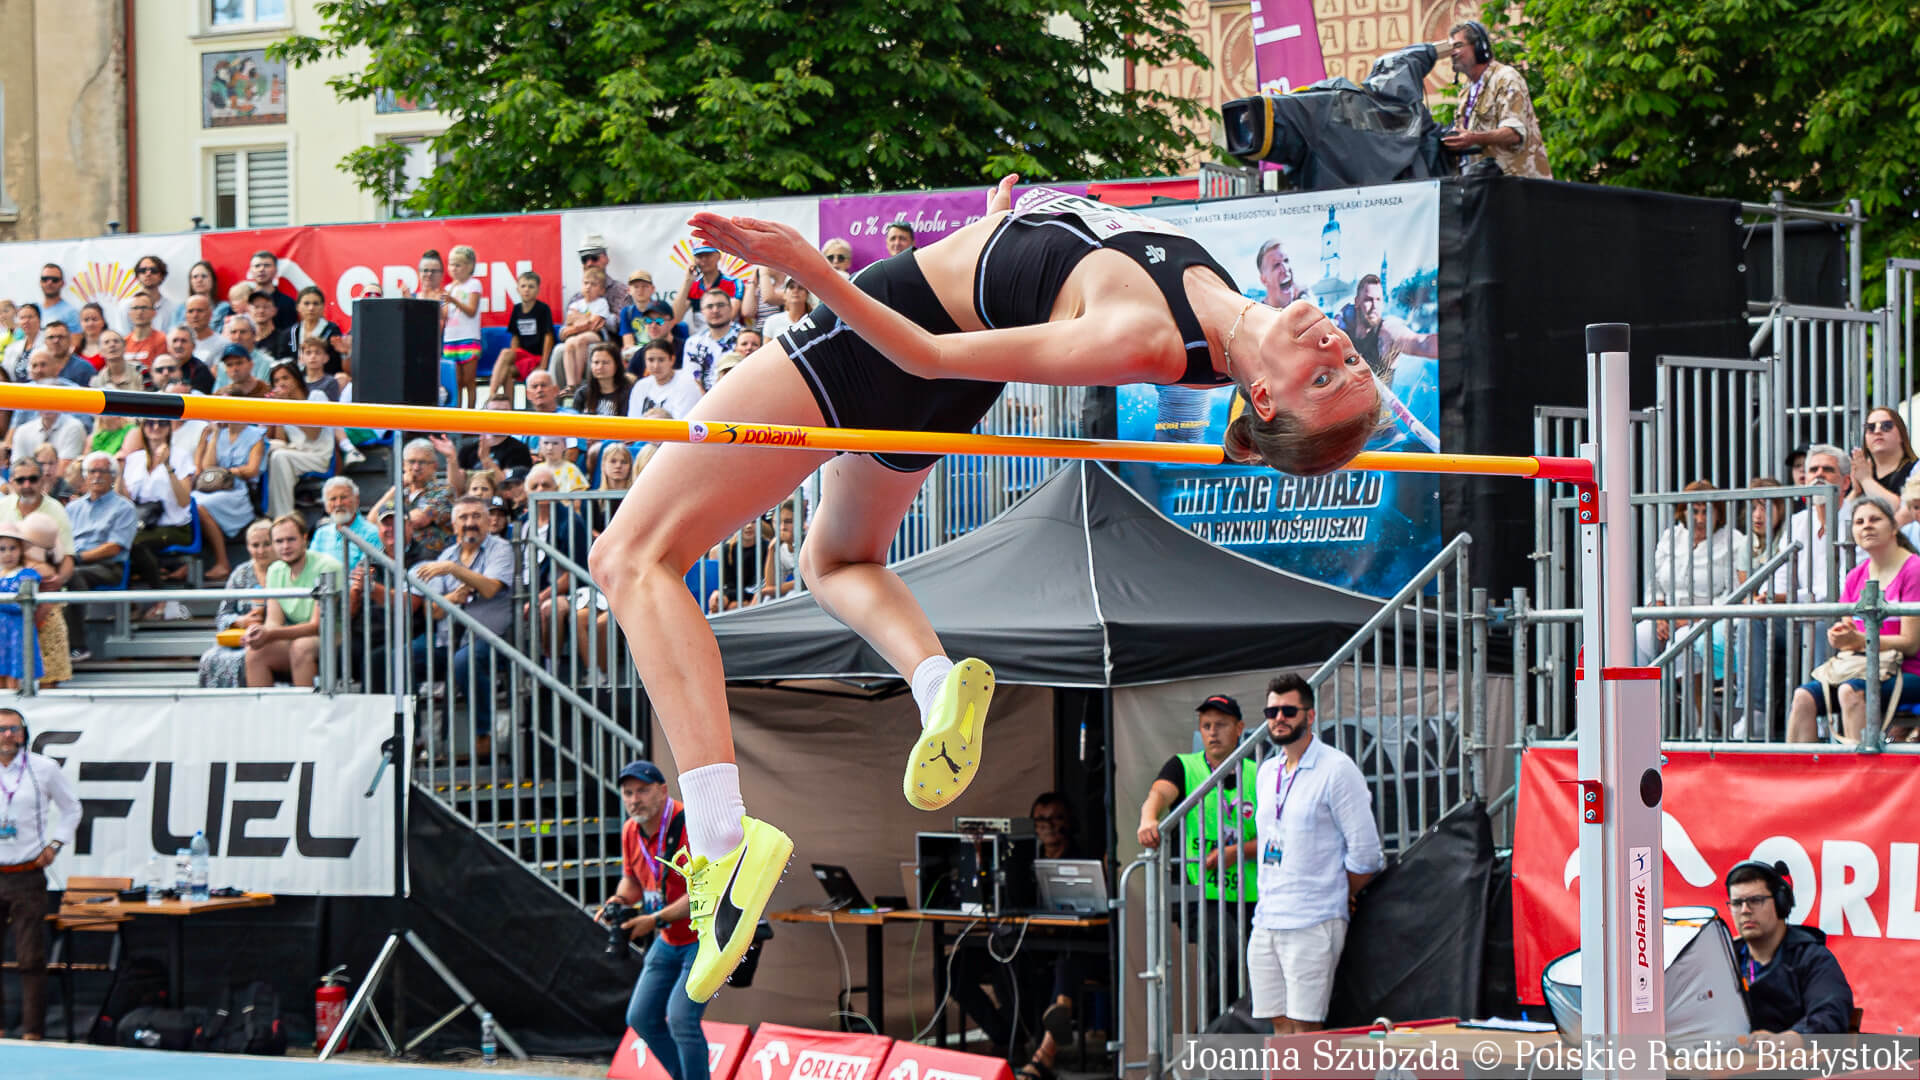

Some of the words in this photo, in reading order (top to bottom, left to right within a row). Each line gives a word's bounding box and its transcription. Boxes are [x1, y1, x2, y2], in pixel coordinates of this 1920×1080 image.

[742, 426, 808, 446] polanik
[1174, 475, 1273, 516] MITYNG
[1276, 471, 1384, 512] GWIAZD
[1213, 520, 1266, 545] RYNKU
[1267, 514, 1368, 543] KOŚCIUSZKI
[75, 761, 360, 859] FUEL
[1634, 884, 1650, 968] polanik
[799, 1056, 863, 1080] ORLEN
